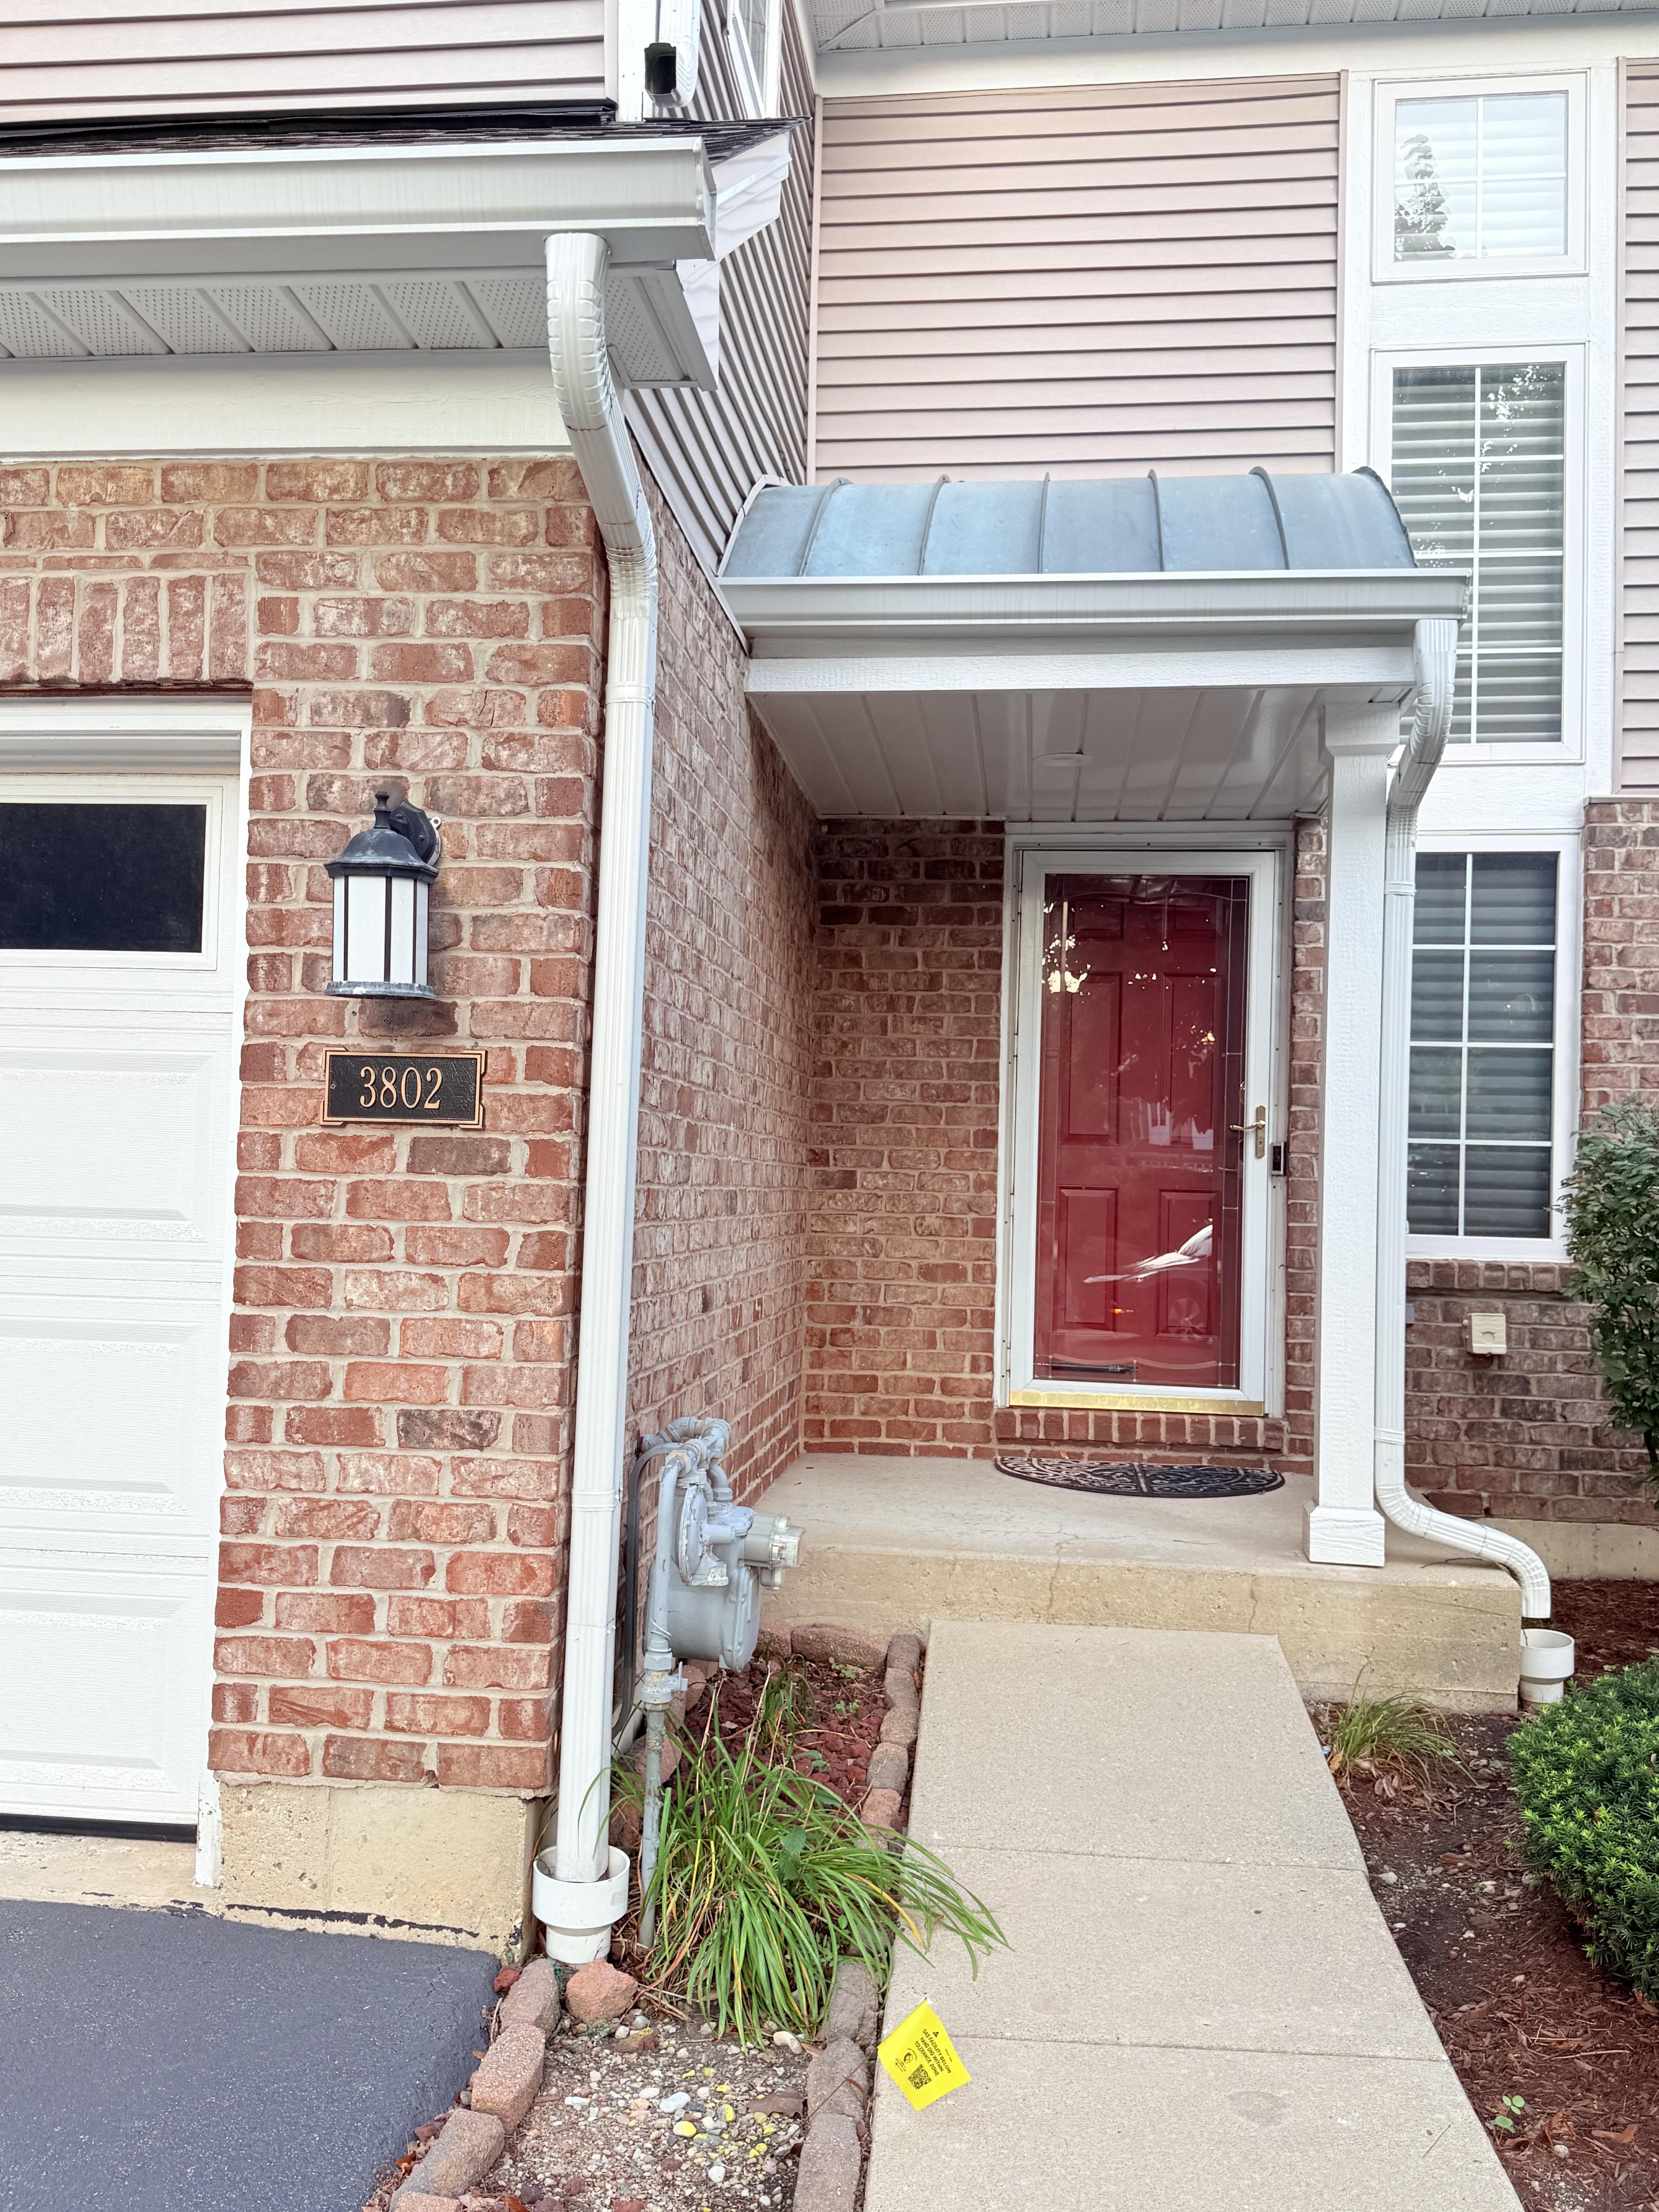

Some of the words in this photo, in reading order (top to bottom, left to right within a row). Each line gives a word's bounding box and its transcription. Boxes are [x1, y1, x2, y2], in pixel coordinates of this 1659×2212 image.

[360, 1066, 443, 1109] 3802
[914, 2040, 932, 2063] TOLERANCE
[930, 2063, 939, 2076] ZONE
[919, 2037, 929, 2048] HAND
[933, 2055, 944, 2072] WITHIN
[928, 2037, 942, 2056] FACILITY
[940, 2056, 951, 2073] BELOW
